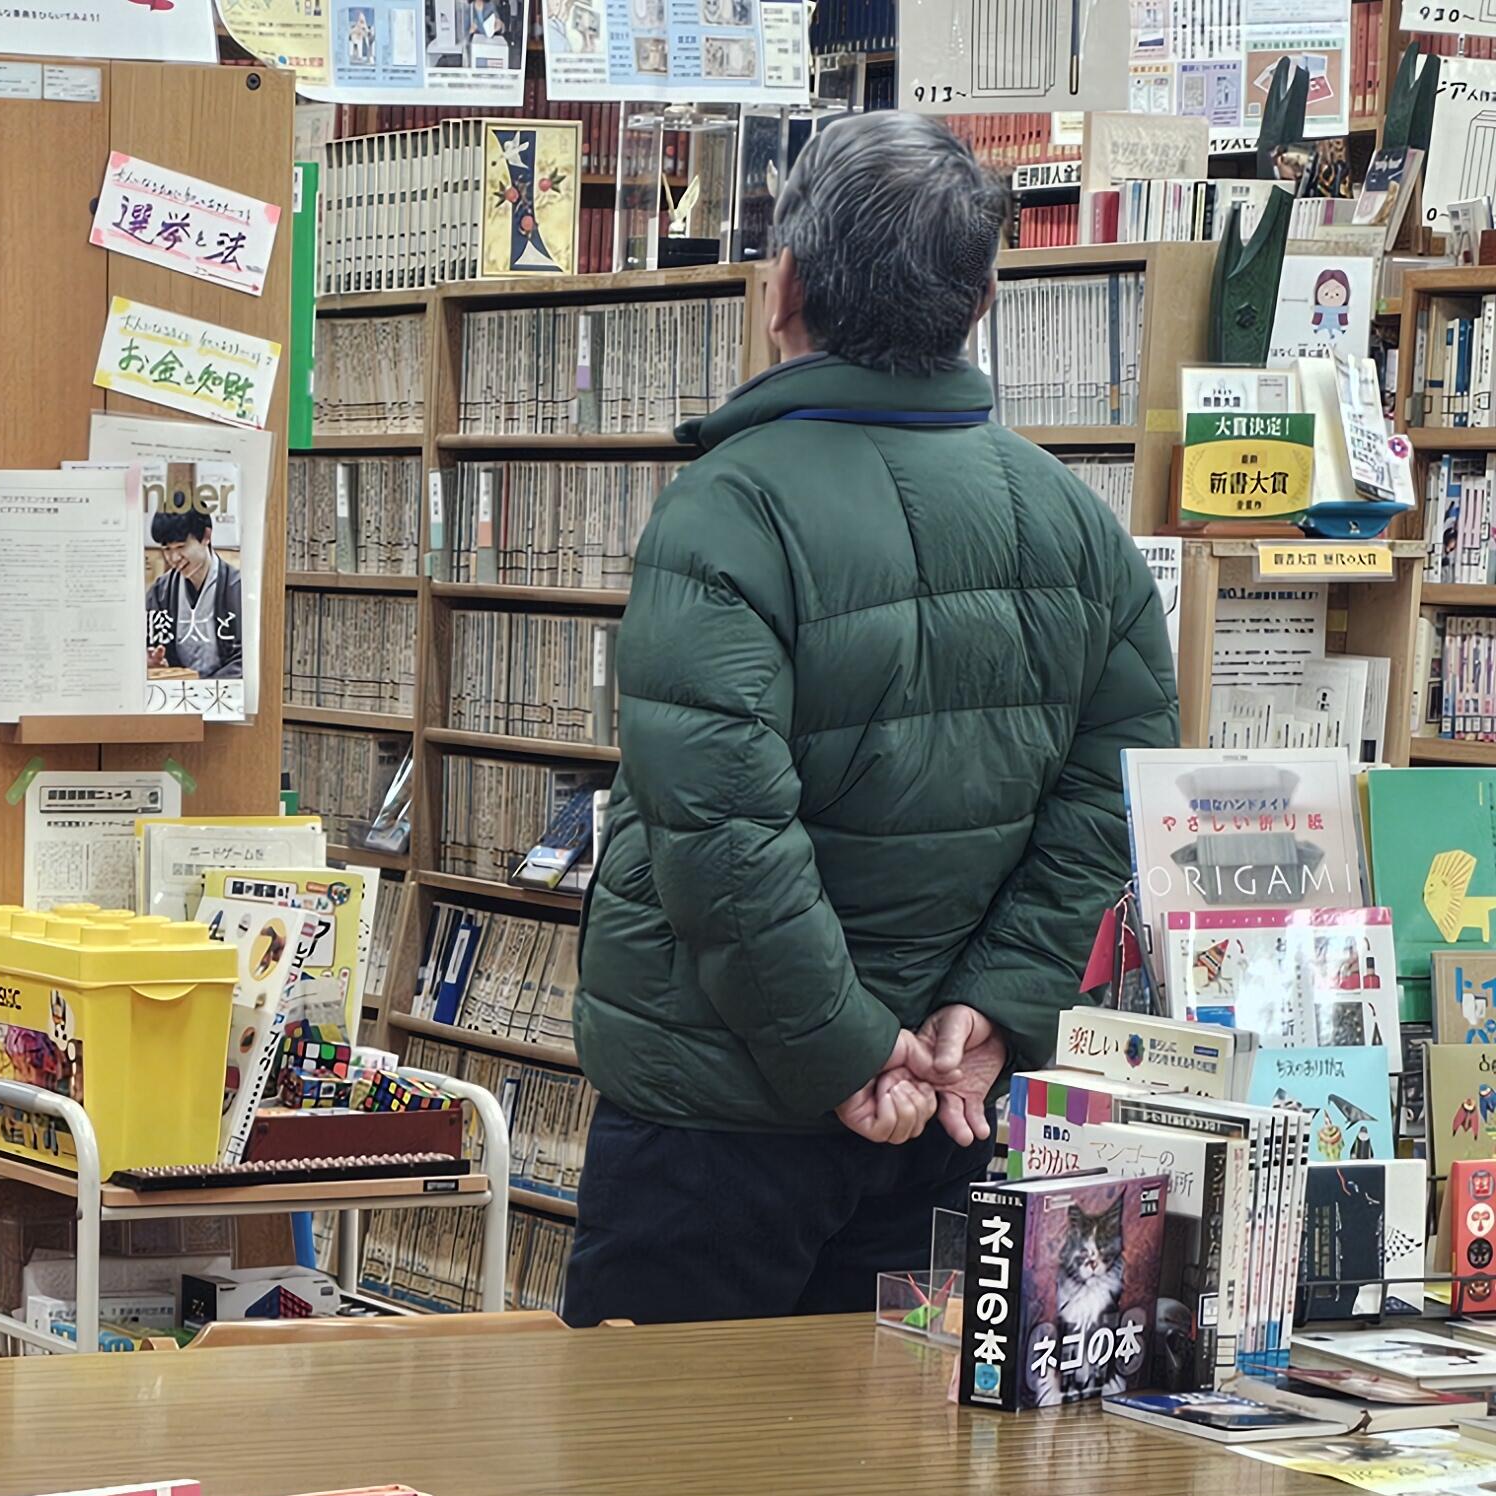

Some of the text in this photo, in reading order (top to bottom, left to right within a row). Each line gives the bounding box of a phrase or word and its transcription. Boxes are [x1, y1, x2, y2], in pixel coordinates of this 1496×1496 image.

[112, 195, 247, 271] 選挙と法
[118, 338, 254, 410] お金と知財
[1210, 471, 1289, 495] 新書大賞
[1161, 813, 1325, 832] やさしい折り紙
[1146, 864, 1353, 897] ORIGAMI
[1069, 1027, 1119, 1056] 楽しい
[1089, 1141, 1175, 1168] マンゴーの
[974, 1215, 1014, 1365] ネコの本
[1031, 1319, 1144, 1377] ネコの本
